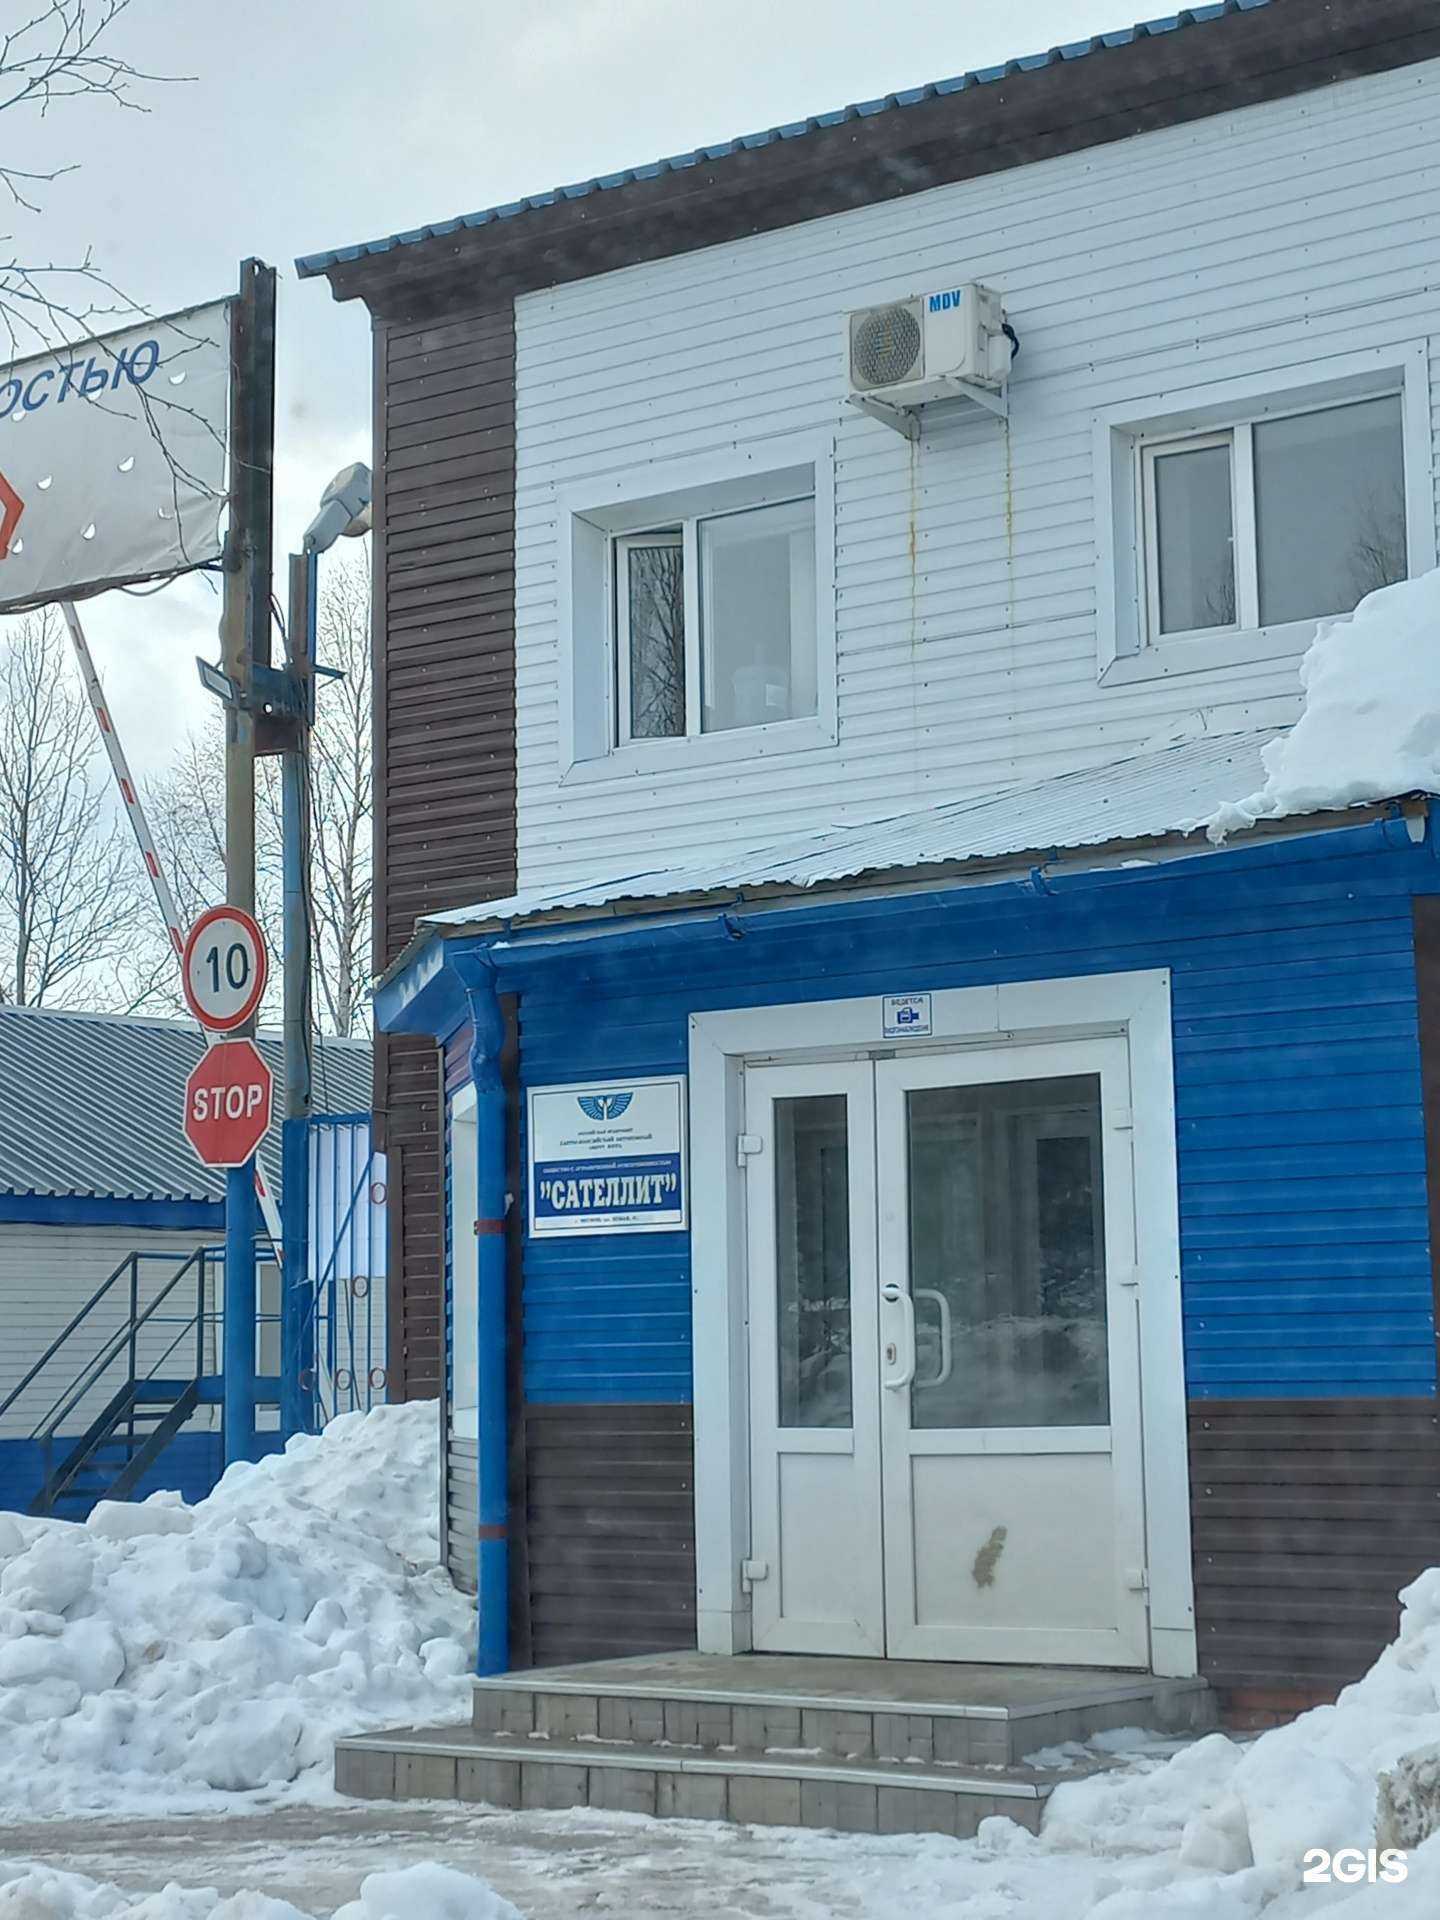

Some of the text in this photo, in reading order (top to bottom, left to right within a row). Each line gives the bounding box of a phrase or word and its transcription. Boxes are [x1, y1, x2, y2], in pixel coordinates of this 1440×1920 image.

[929, 290, 961, 313] MDV
[206, 943, 249, 993] 10
[192, 1083, 264, 1122] STOP
